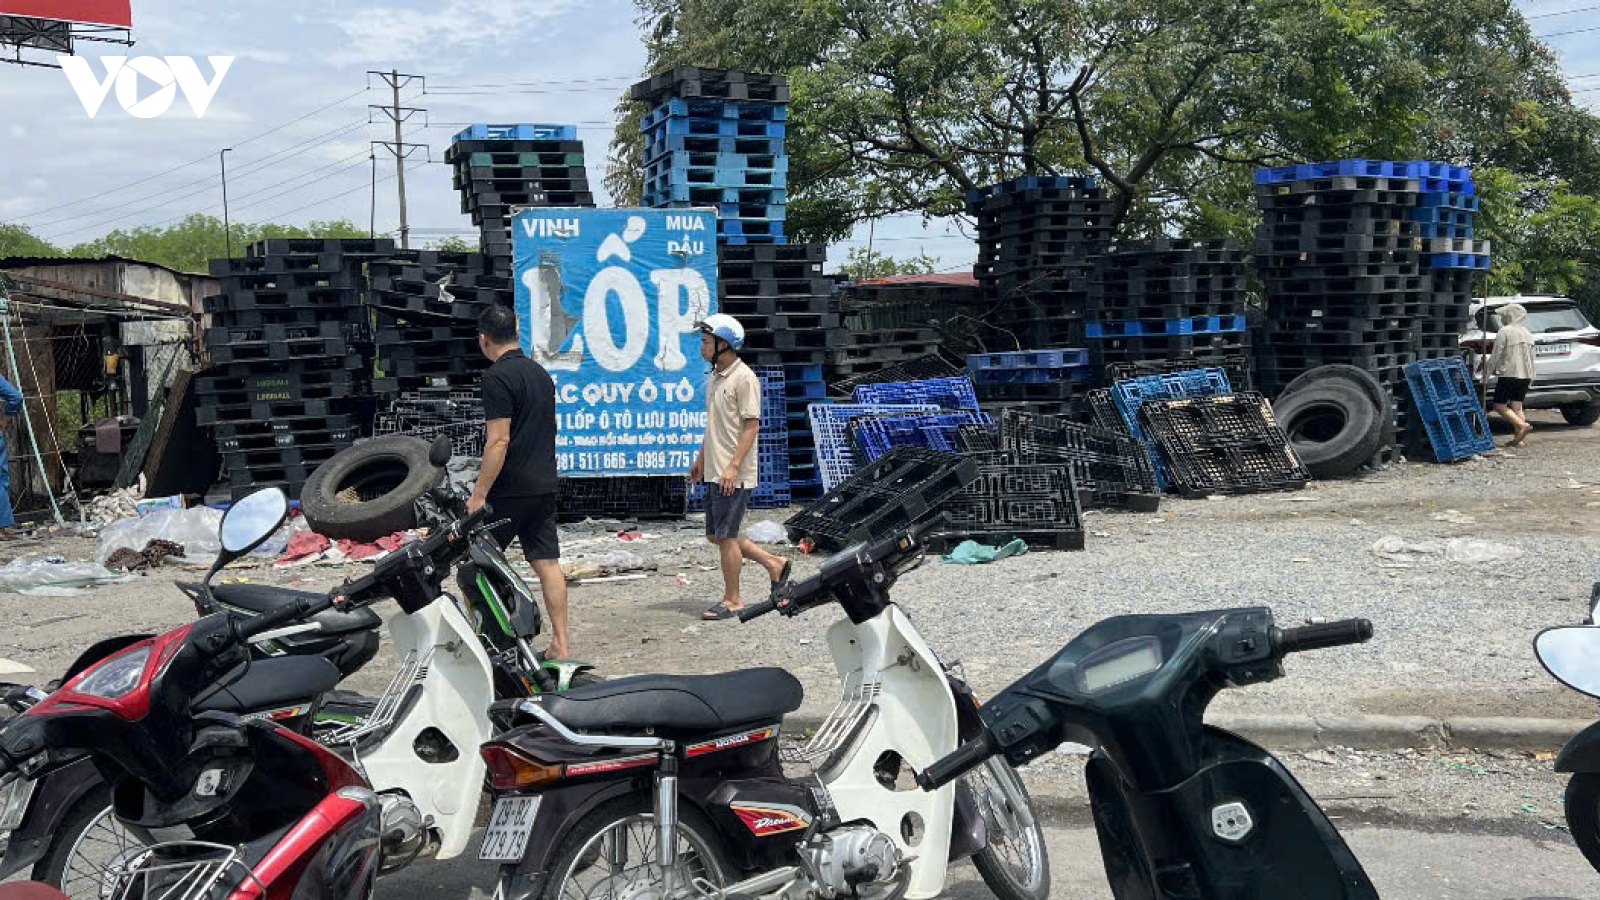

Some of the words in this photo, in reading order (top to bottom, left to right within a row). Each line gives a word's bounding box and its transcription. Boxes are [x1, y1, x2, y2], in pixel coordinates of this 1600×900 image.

[521, 218, 579, 238] VINH
[666, 215, 705, 230] MUA
[522, 216, 710, 372] LỐP
[582, 382, 635, 407] QUY
[638, 376, 658, 403] Ô
[662, 376, 695, 402] TÔ
[566, 408, 596, 430] LỐP
[599, 410, 610, 430] Ô
[613, 409, 632, 430] TÔ
[578, 452, 600, 470] 511
[603, 452, 626, 469] 666
[636, 451, 666, 468] 0989
[668, 451, 690, 467] 775
